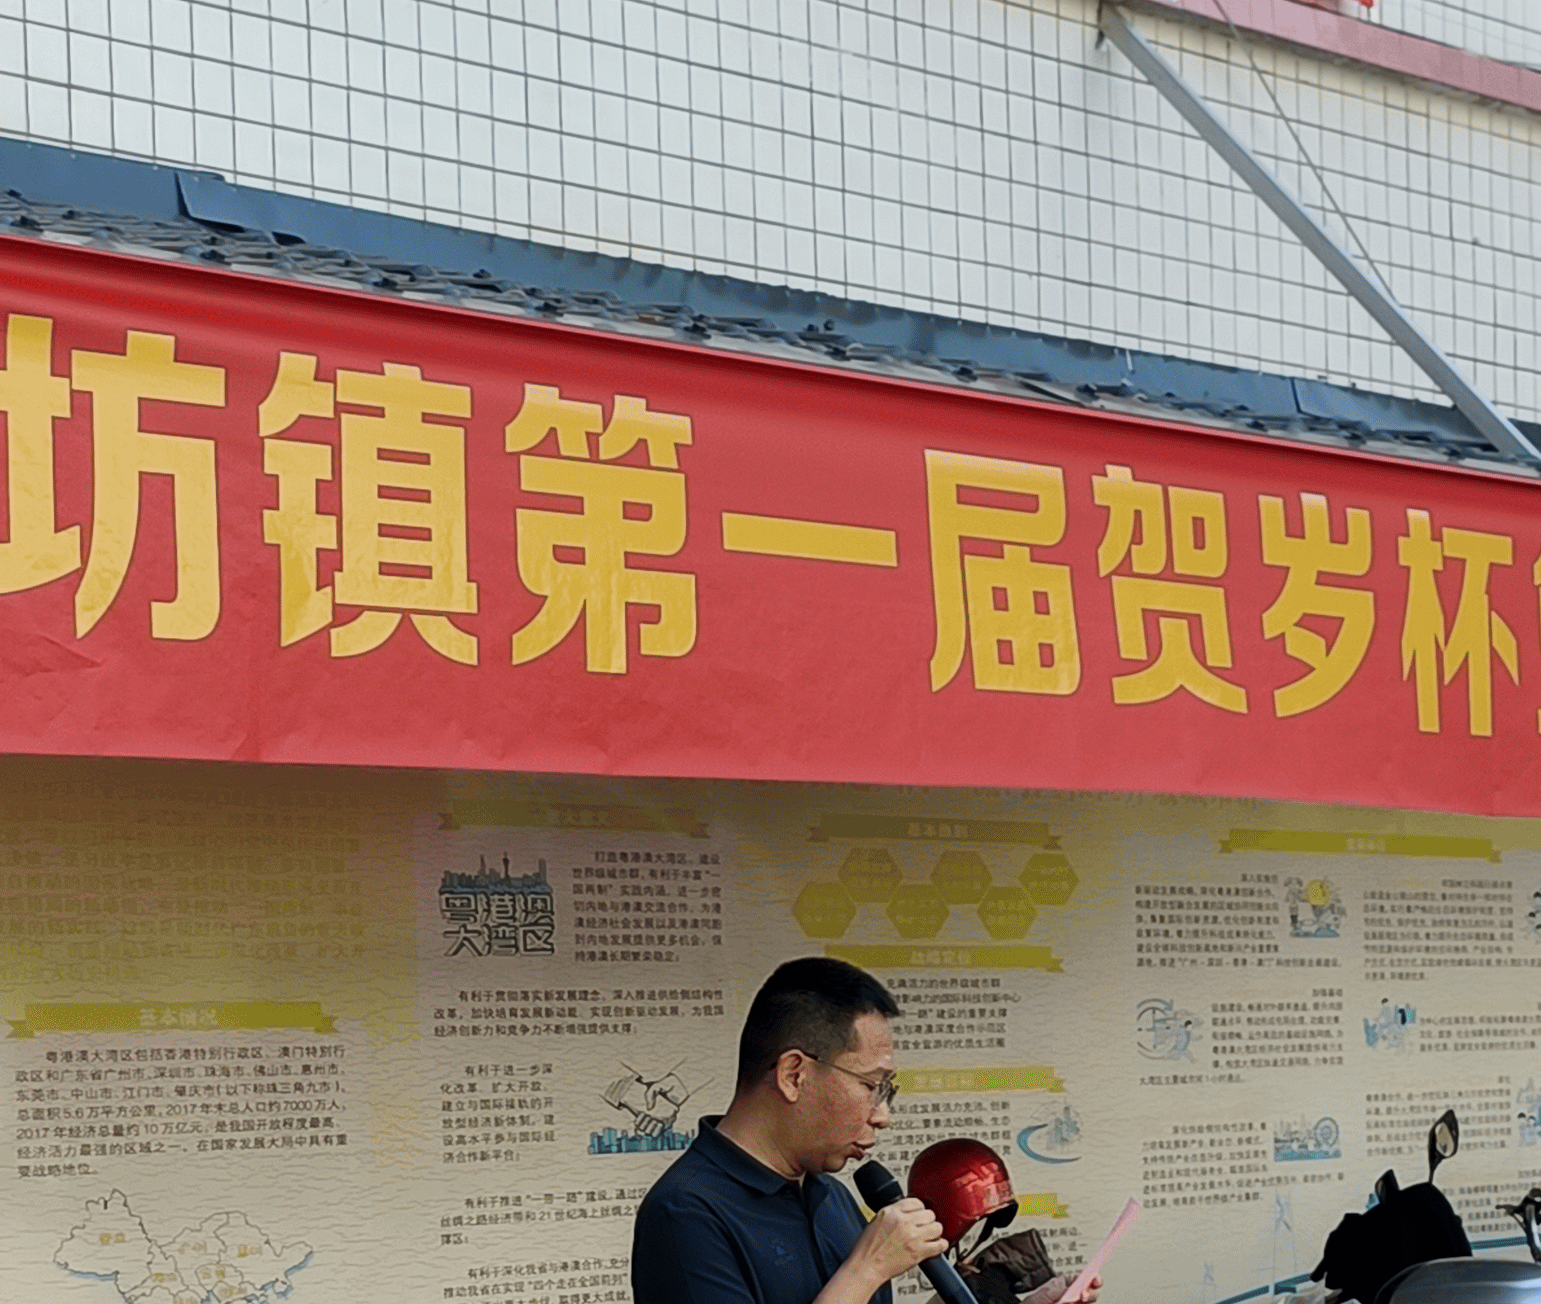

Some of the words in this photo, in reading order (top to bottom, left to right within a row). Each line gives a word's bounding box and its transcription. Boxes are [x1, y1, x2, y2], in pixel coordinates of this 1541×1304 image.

[439, 891, 554, 924] 粤港澳
[442, 922, 555, 957] 大湾区
